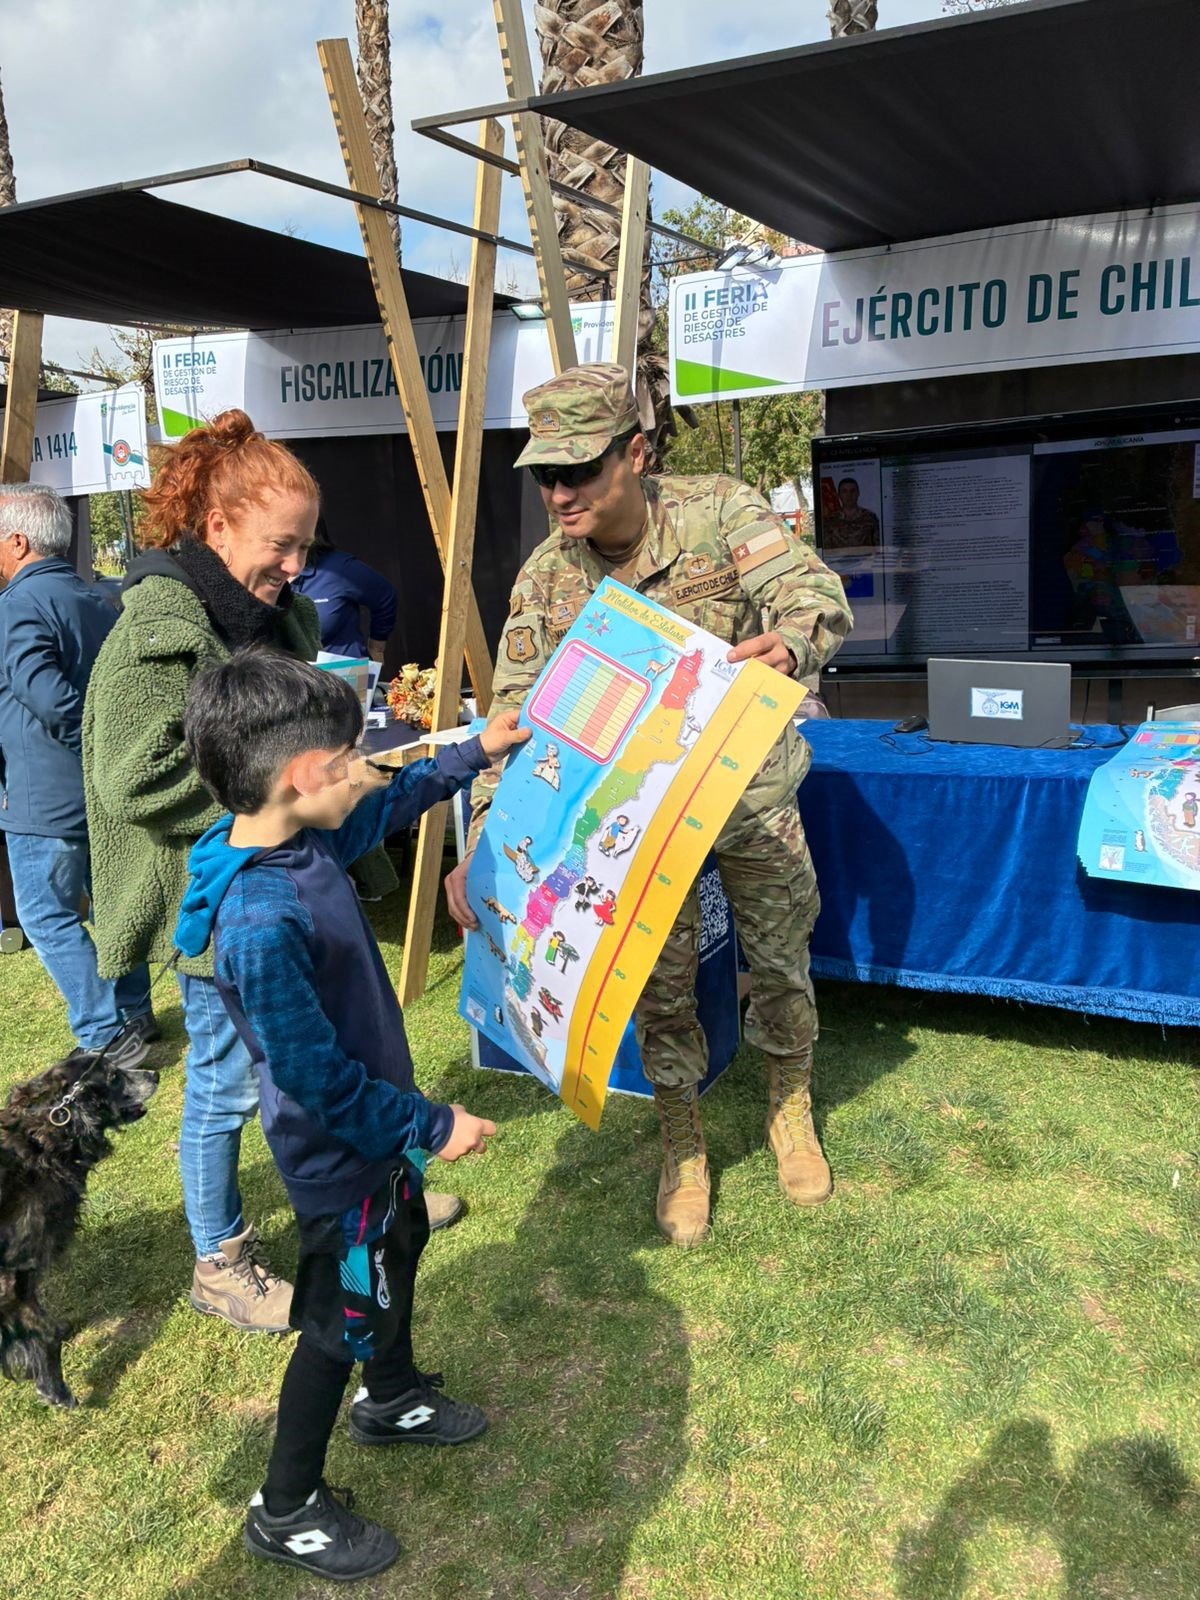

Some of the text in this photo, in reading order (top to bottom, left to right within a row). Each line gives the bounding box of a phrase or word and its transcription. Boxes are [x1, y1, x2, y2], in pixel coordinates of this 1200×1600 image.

[685, 283, 768, 311] II FERIA
[821, 256, 1200, 348] EJÉRCITO DE CHIL
[684, 301, 768, 323] DE GESTIÓN DE
[583, 320, 615, 329] Providen
[684, 317, 742, 334] RIESGO DE
[684, 327, 746, 344] DESASTRES
[163, 350, 217, 369] II FERIA
[163, 369, 173, 378] DE
[206, 366, 217, 375] DE
[163, 376, 201, 387] RIESGO DE
[280, 346, 464, 403] FISCALIZAIÓN
[164, 384, 205, 396] DESASTRES
[32, 431, 78, 462] A 1414
[675, 569, 739, 600] EJERCITO DE CHILE
[714, 658, 738, 677] IGM
[1000, 701, 1020, 711] IGM
